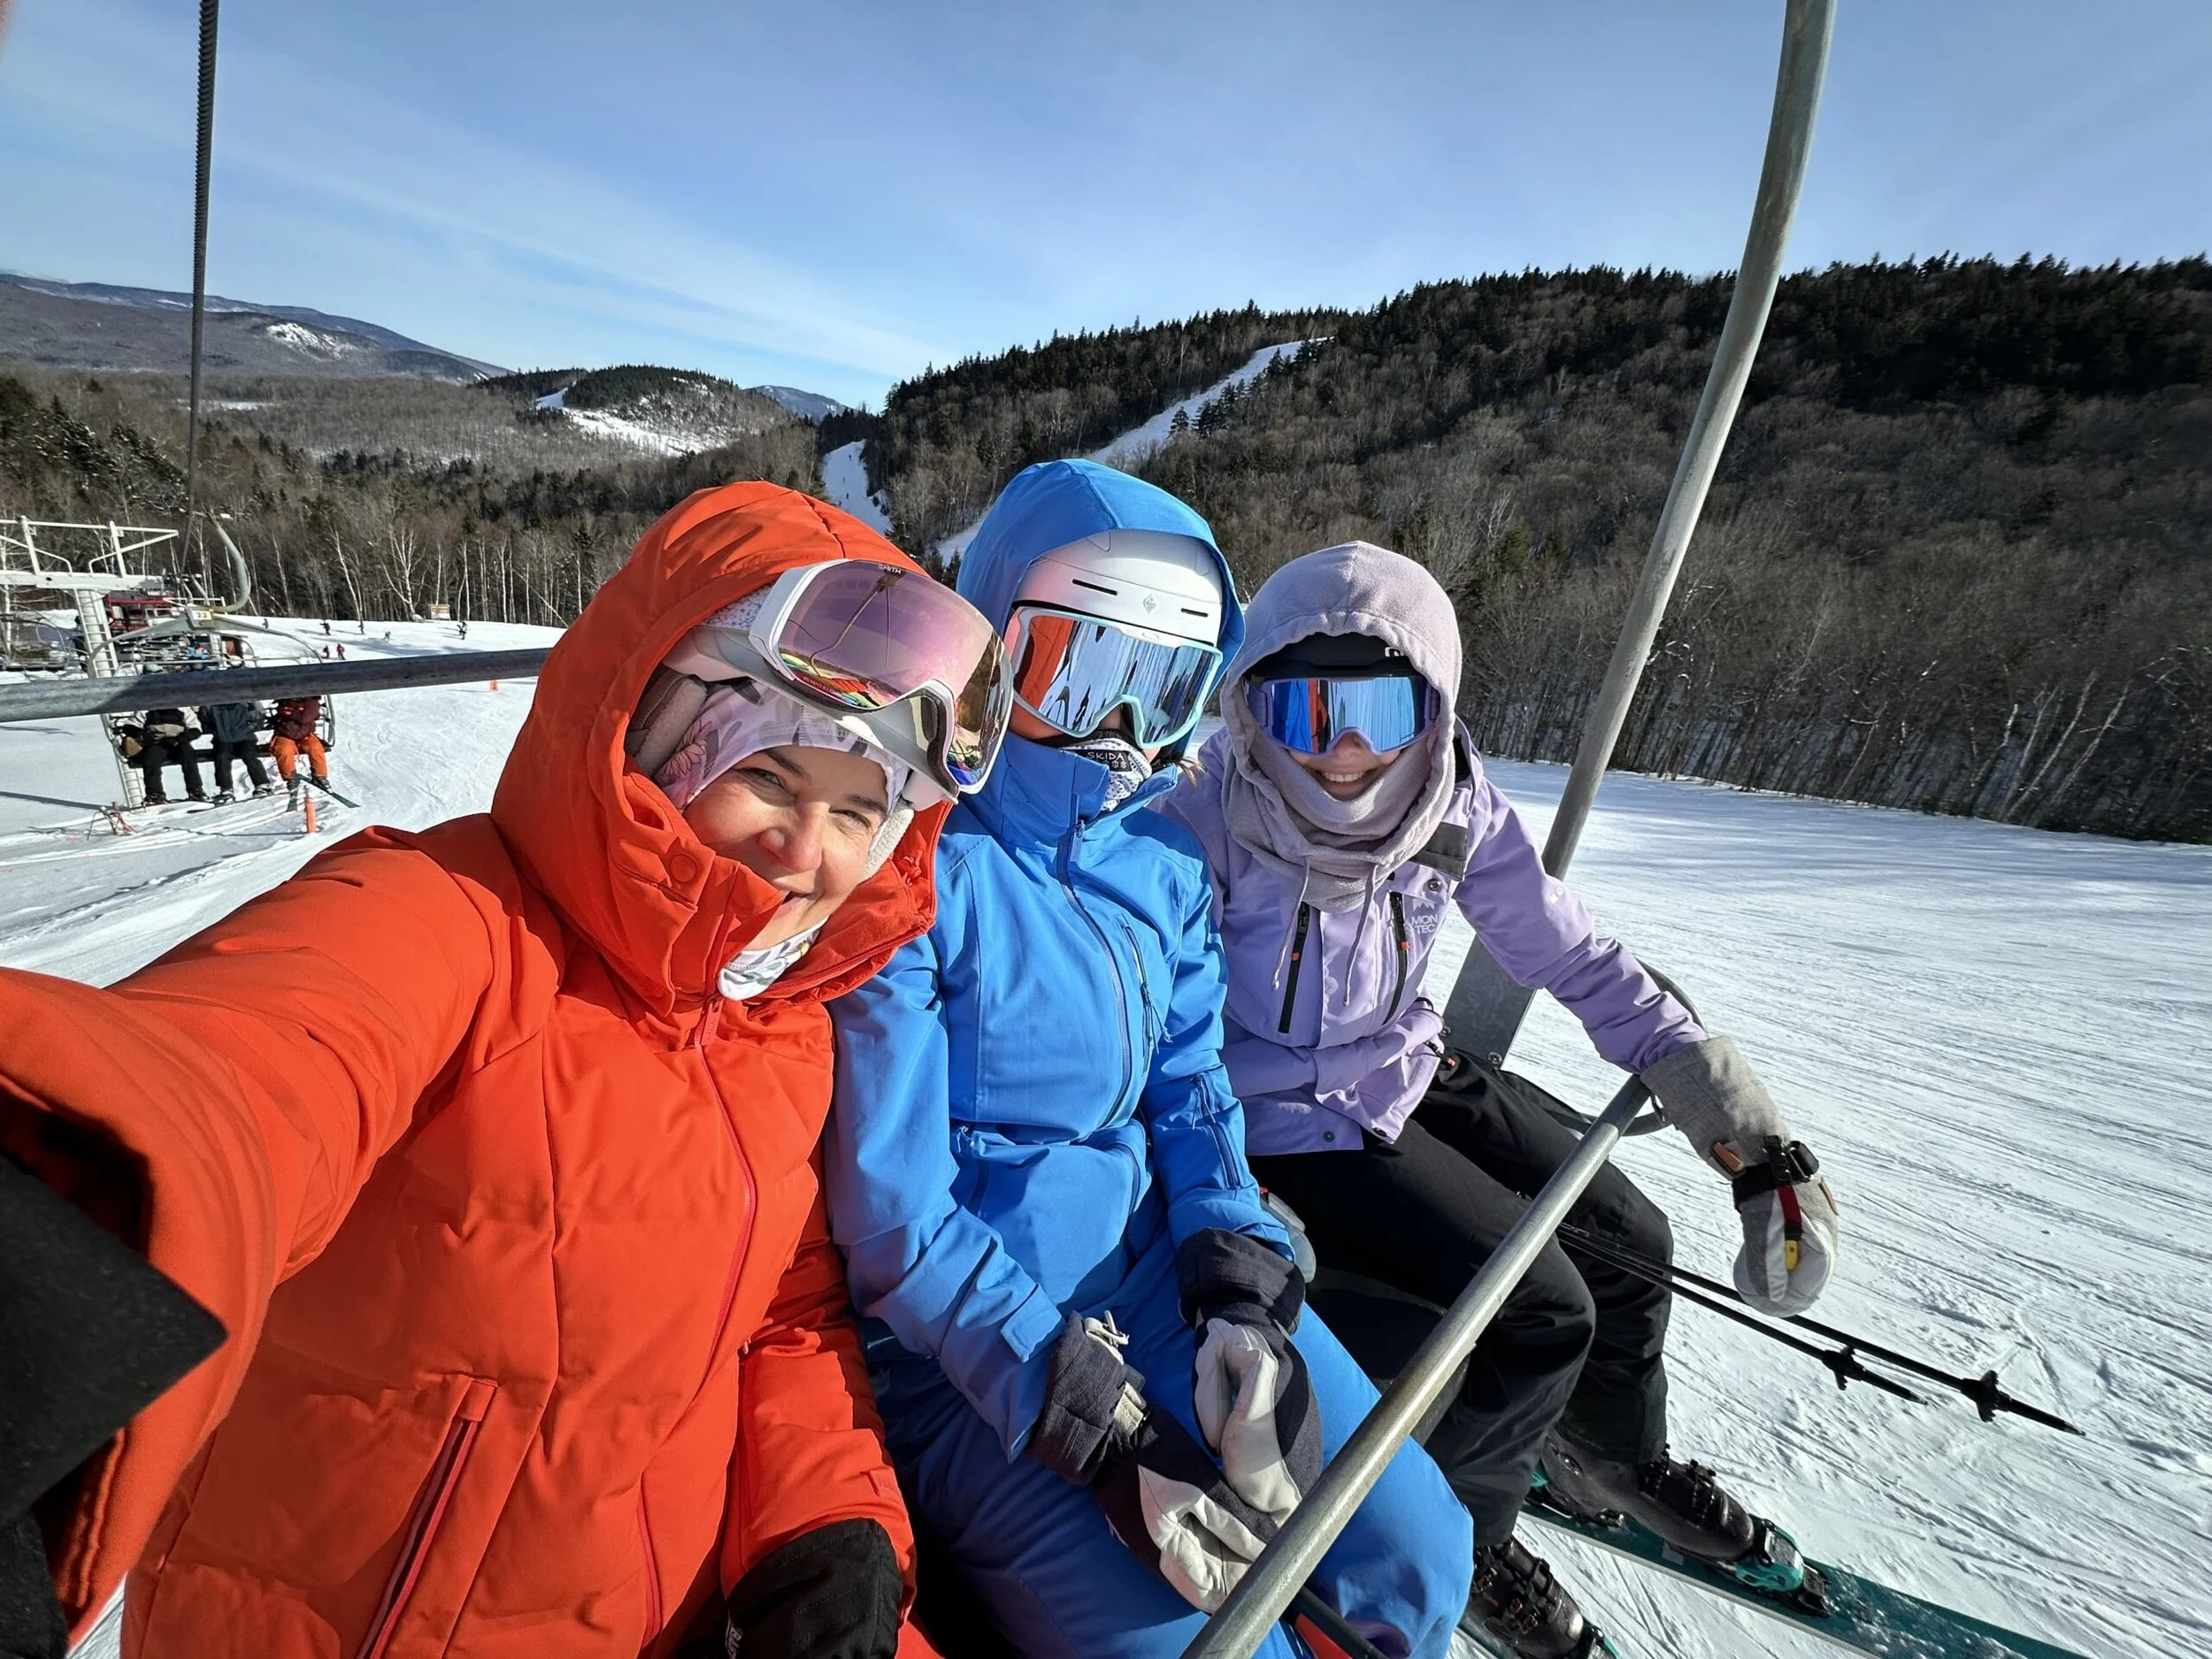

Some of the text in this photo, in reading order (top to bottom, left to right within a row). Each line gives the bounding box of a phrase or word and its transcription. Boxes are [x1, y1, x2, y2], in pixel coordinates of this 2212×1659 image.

[1087, 751, 1125, 761] SKIDA
[1411, 914, 1439, 926] MON
[1414, 924, 1436, 934] TEC
